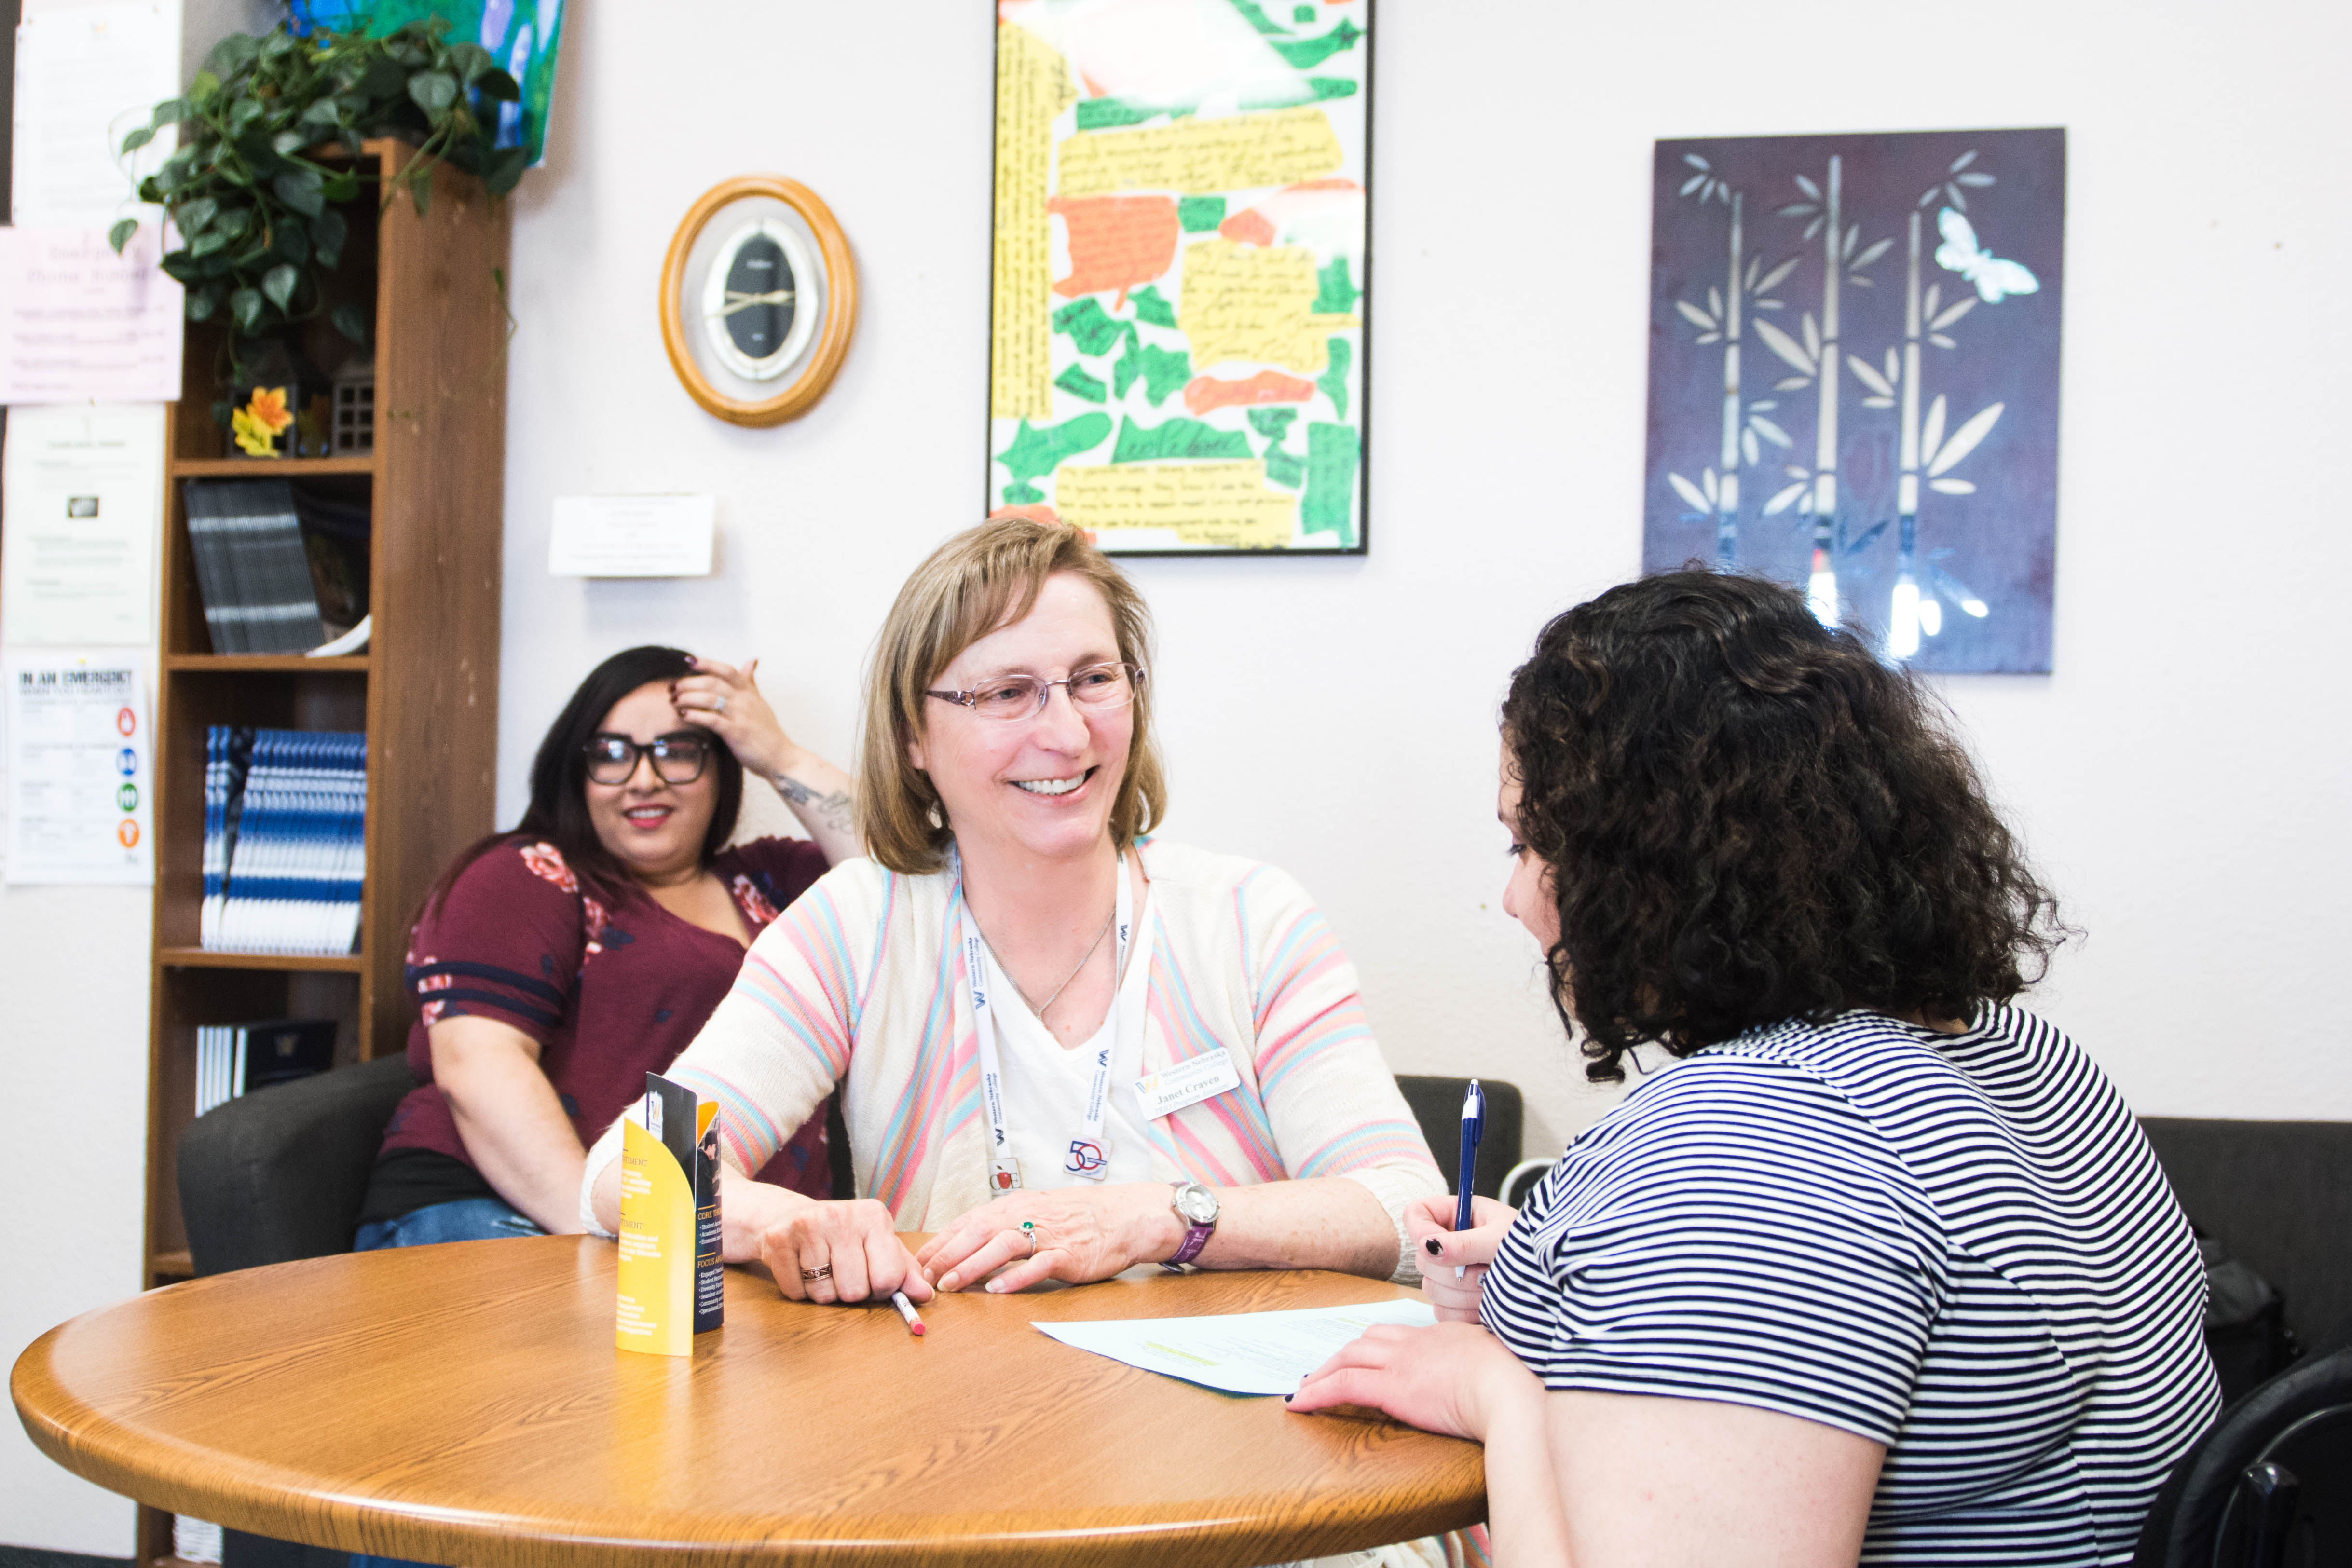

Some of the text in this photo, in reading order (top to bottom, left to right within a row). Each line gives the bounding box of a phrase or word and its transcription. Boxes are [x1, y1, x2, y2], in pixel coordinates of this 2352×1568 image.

[19, 669, 132, 684] IN AN EMERGENCY
[1160, 1064, 1191, 1078] Western
[1191, 1050, 1227, 1066] Nebraska
[1164, 1058, 1229, 1086] Community College
[1090, 1070, 1100, 1100] Community
[1158, 1076, 1220, 1105] Janet Craven
[1093, 1095, 1102, 1122] Nebraska
[1065, 1140, 1103, 1172] 50
[697, 1211, 712, 1221] CORE
[701, 1222, 714, 1230] Student
[701, 1229, 717, 1238] Academic
[701, 1236, 717, 1245] Economic
[697, 1257, 715, 1268] FOCUS
[700, 1269, 715, 1279] Engaged
[700, 1277, 714, 1285] Student
[700, 1291, 716, 1300] Seamless
[700, 1298, 719, 1307] Community
[700, 1304, 719, 1315] Operational
